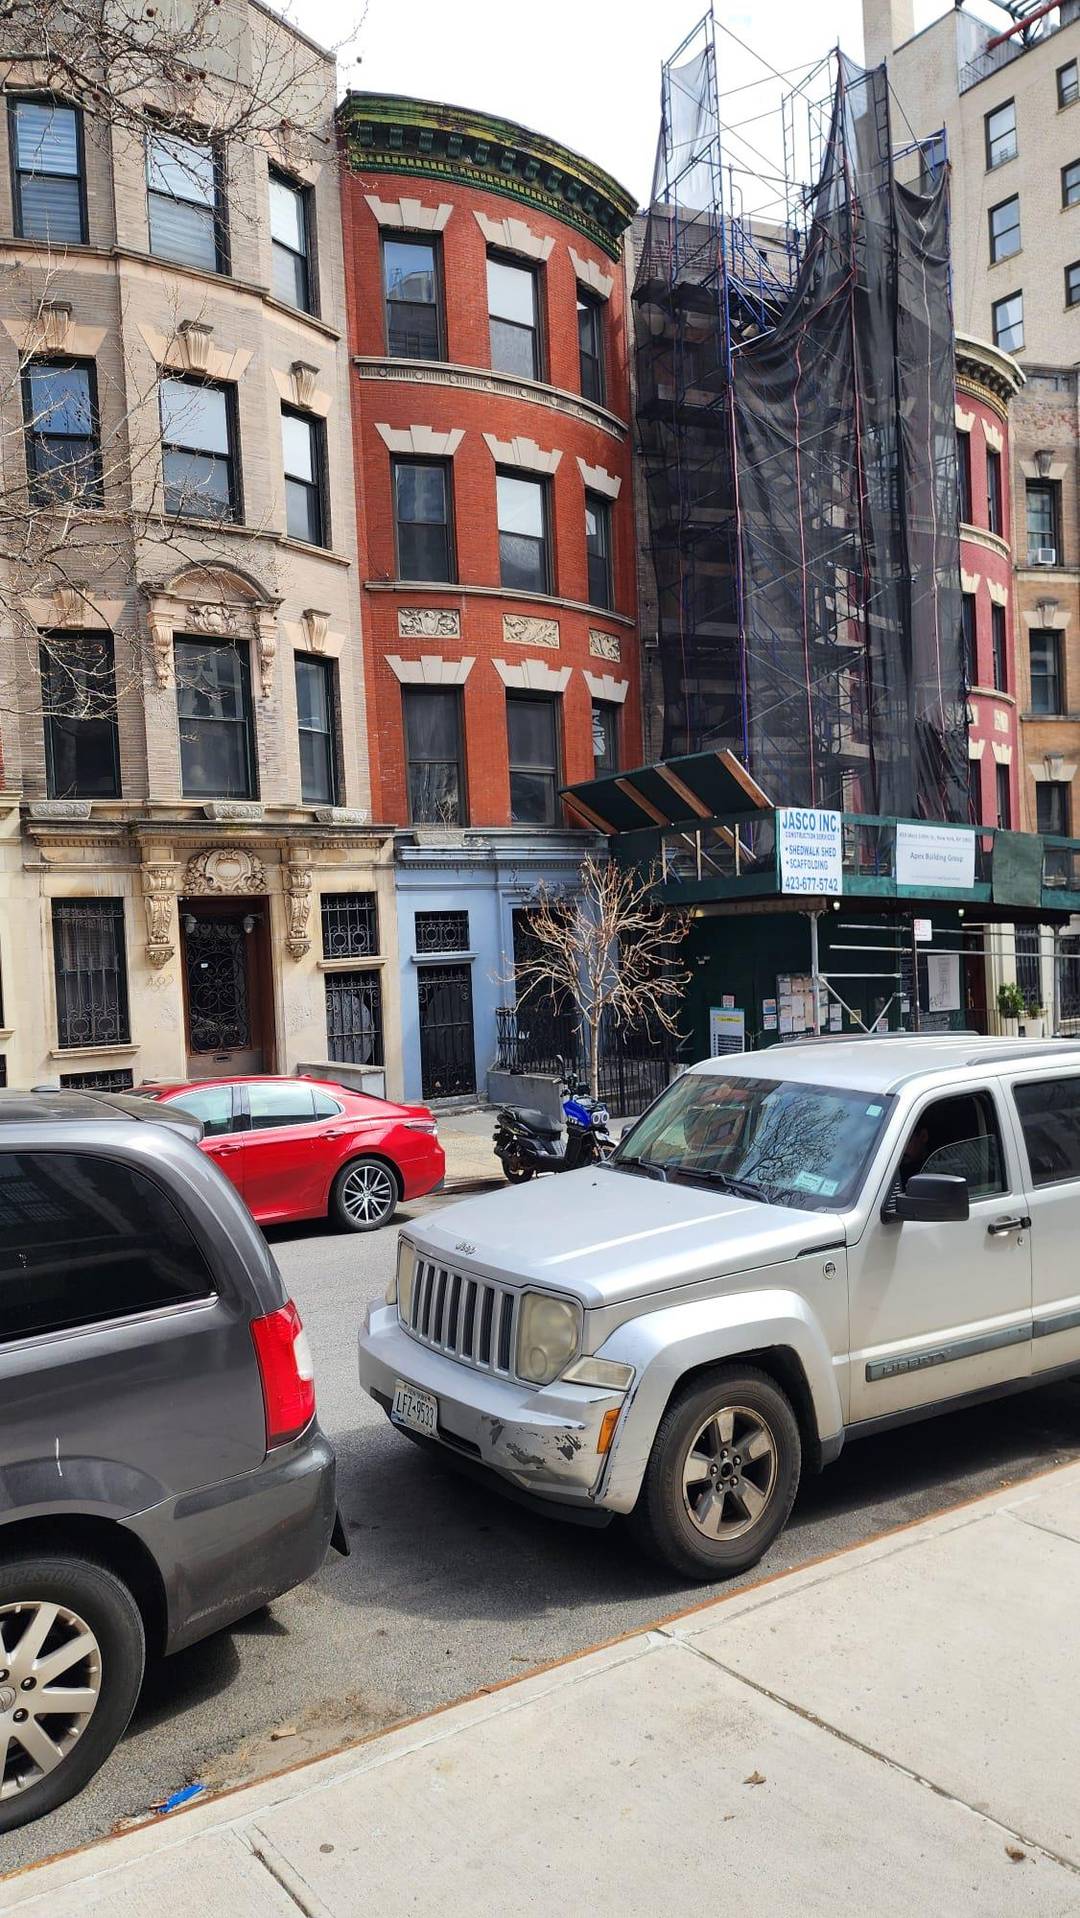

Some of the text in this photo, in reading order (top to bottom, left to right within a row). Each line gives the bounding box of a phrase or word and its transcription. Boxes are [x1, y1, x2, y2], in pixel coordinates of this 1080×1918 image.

[783, 812, 840, 833] JASCO INC.
[821, 846, 837, 857] SHED
[910, 852, 964, 863] Apex Building Group
[790, 858, 828, 870] SCAFFOLDING
[785, 876, 838, 891] 423-677-5742
